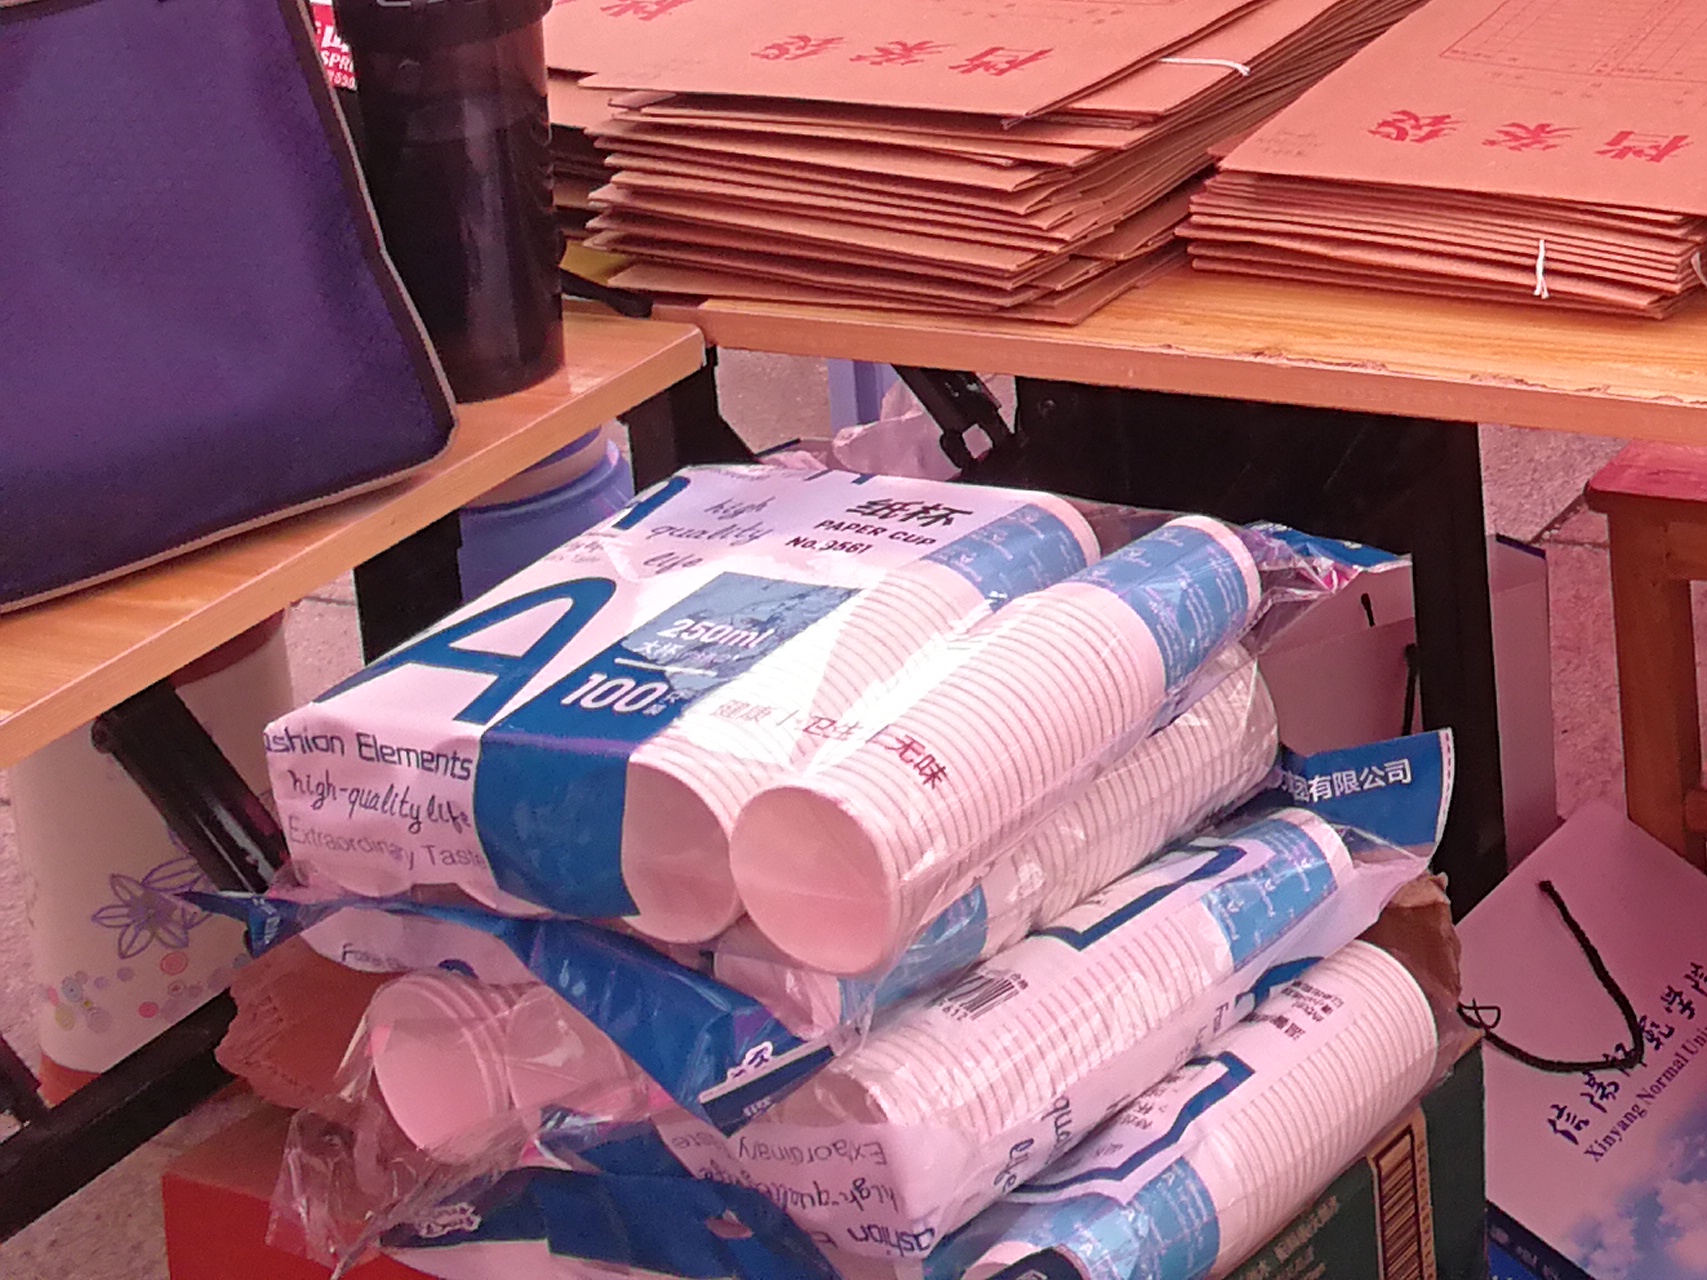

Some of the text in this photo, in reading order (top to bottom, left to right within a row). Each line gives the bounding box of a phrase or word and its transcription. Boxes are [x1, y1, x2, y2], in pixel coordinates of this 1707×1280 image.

[750, 34, 1055, 77] 档案袋
[1367, 109, 1694, 165] 档案袋
[703, 496, 776, 526] high
[845, 496, 974, 528] 纸杯
[651, 521, 774, 547] quality
[815, 519, 939, 547] PAPER CUP
[656, 618, 775, 650] 250ml
[560, 672, 670, 714] 100
[356, 731, 474, 782] Elements
[886, 733, 949, 791] 无味
[287, 768, 473, 834] high-quality life
[288, 814, 415, 871] Extraordinary
[1583, 1101, 1649, 1163] Xinyang
[1636, 1049, 1690, 1106] Normal
